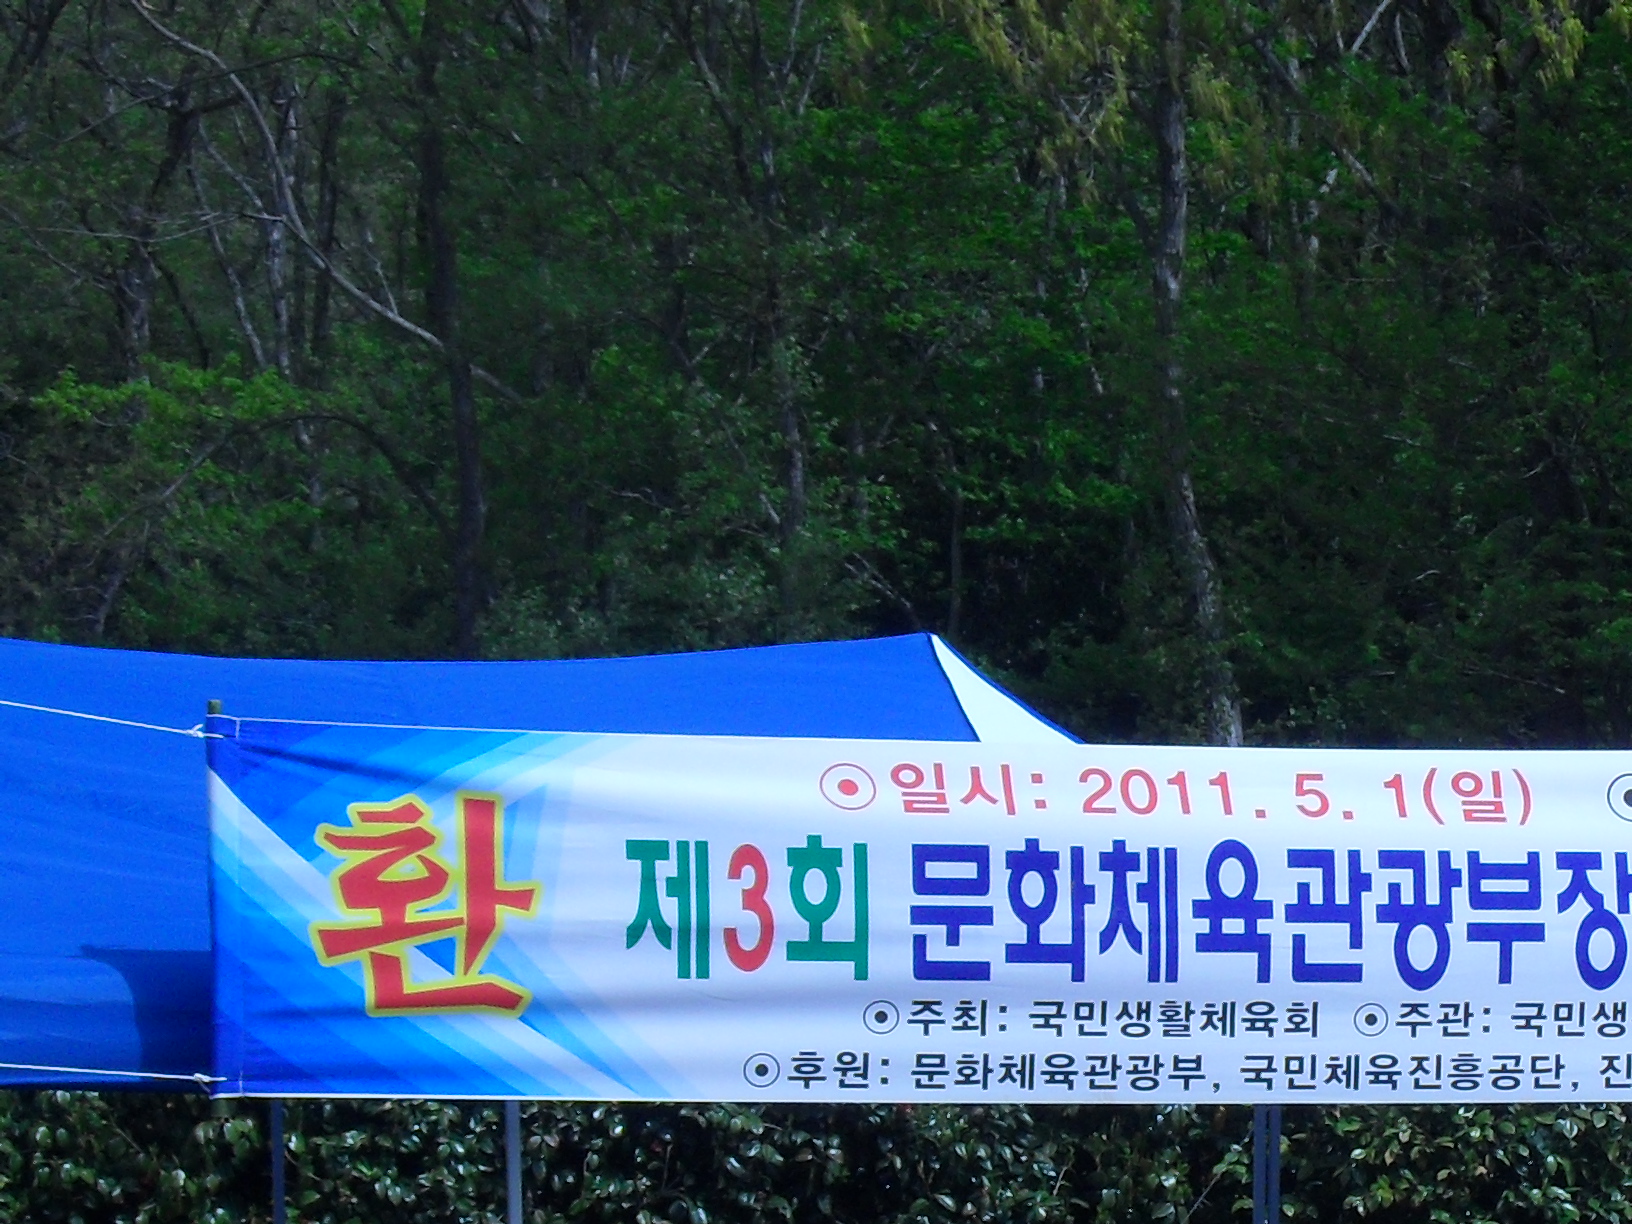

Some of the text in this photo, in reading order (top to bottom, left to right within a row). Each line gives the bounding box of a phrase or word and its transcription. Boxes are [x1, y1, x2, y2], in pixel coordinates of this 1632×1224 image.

[889, 762, 1048, 816] 일시:
[308, 790, 545, 1018] 환
[624, 833, 871, 982] 제3회
[903, 997, 1011, 1038] 주최:
[1026, 997, 1320, 1039] 국민생활체육회
[1394, 1001, 1492, 1039] 주관:
[786, 1050, 891, 1090] 후원:
[910, 1052, 1221, 1094] 문화체육관광부,
[1239, 1052, 1580, 1093] 국민체육진흥공단,
